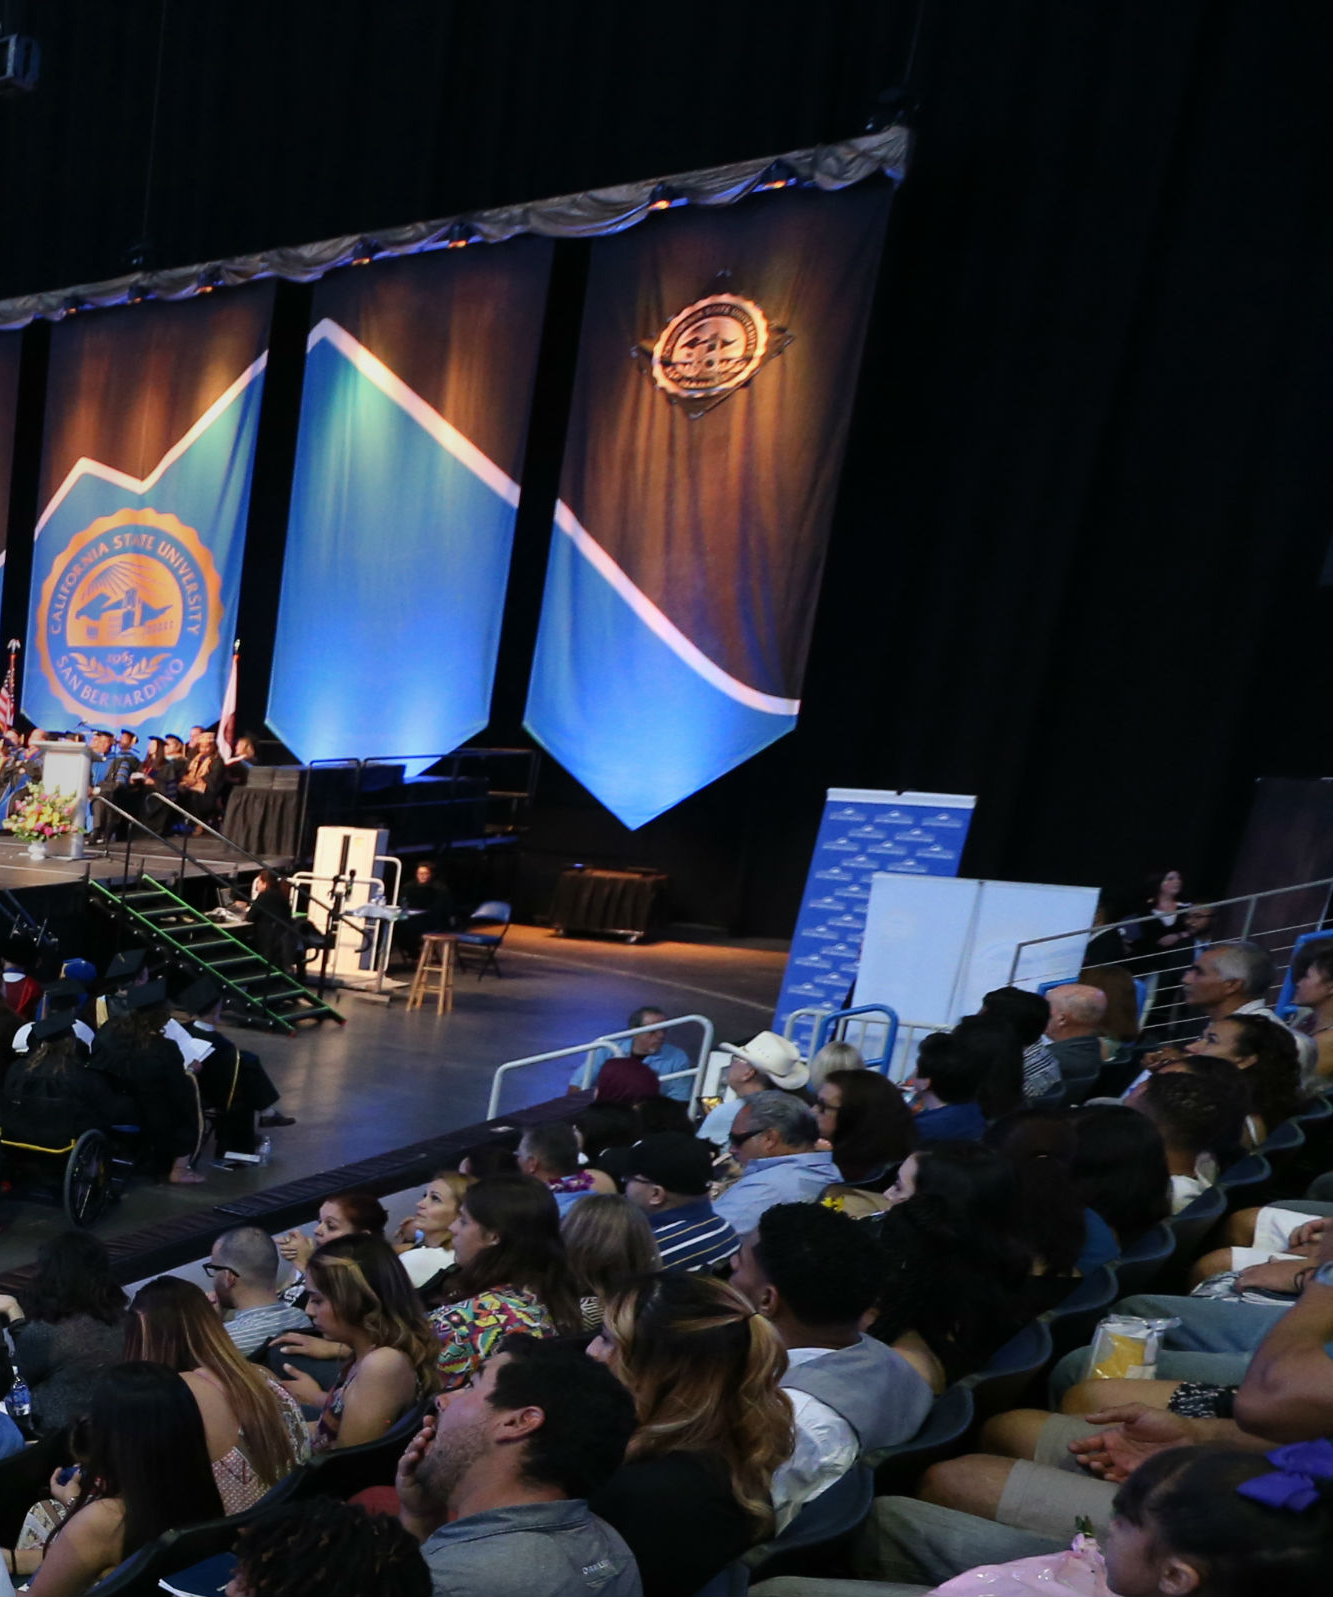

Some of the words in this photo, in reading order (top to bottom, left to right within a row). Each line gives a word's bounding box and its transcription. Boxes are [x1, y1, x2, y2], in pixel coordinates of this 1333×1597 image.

[51, 542, 109, 635] CALIFORNIA
[113, 533, 156, 550] STATE
[157, 541, 202, 635] UNIVERSITY
[57, 656, 82, 690] SAN
[83, 658, 184, 708] BERNARDINO
